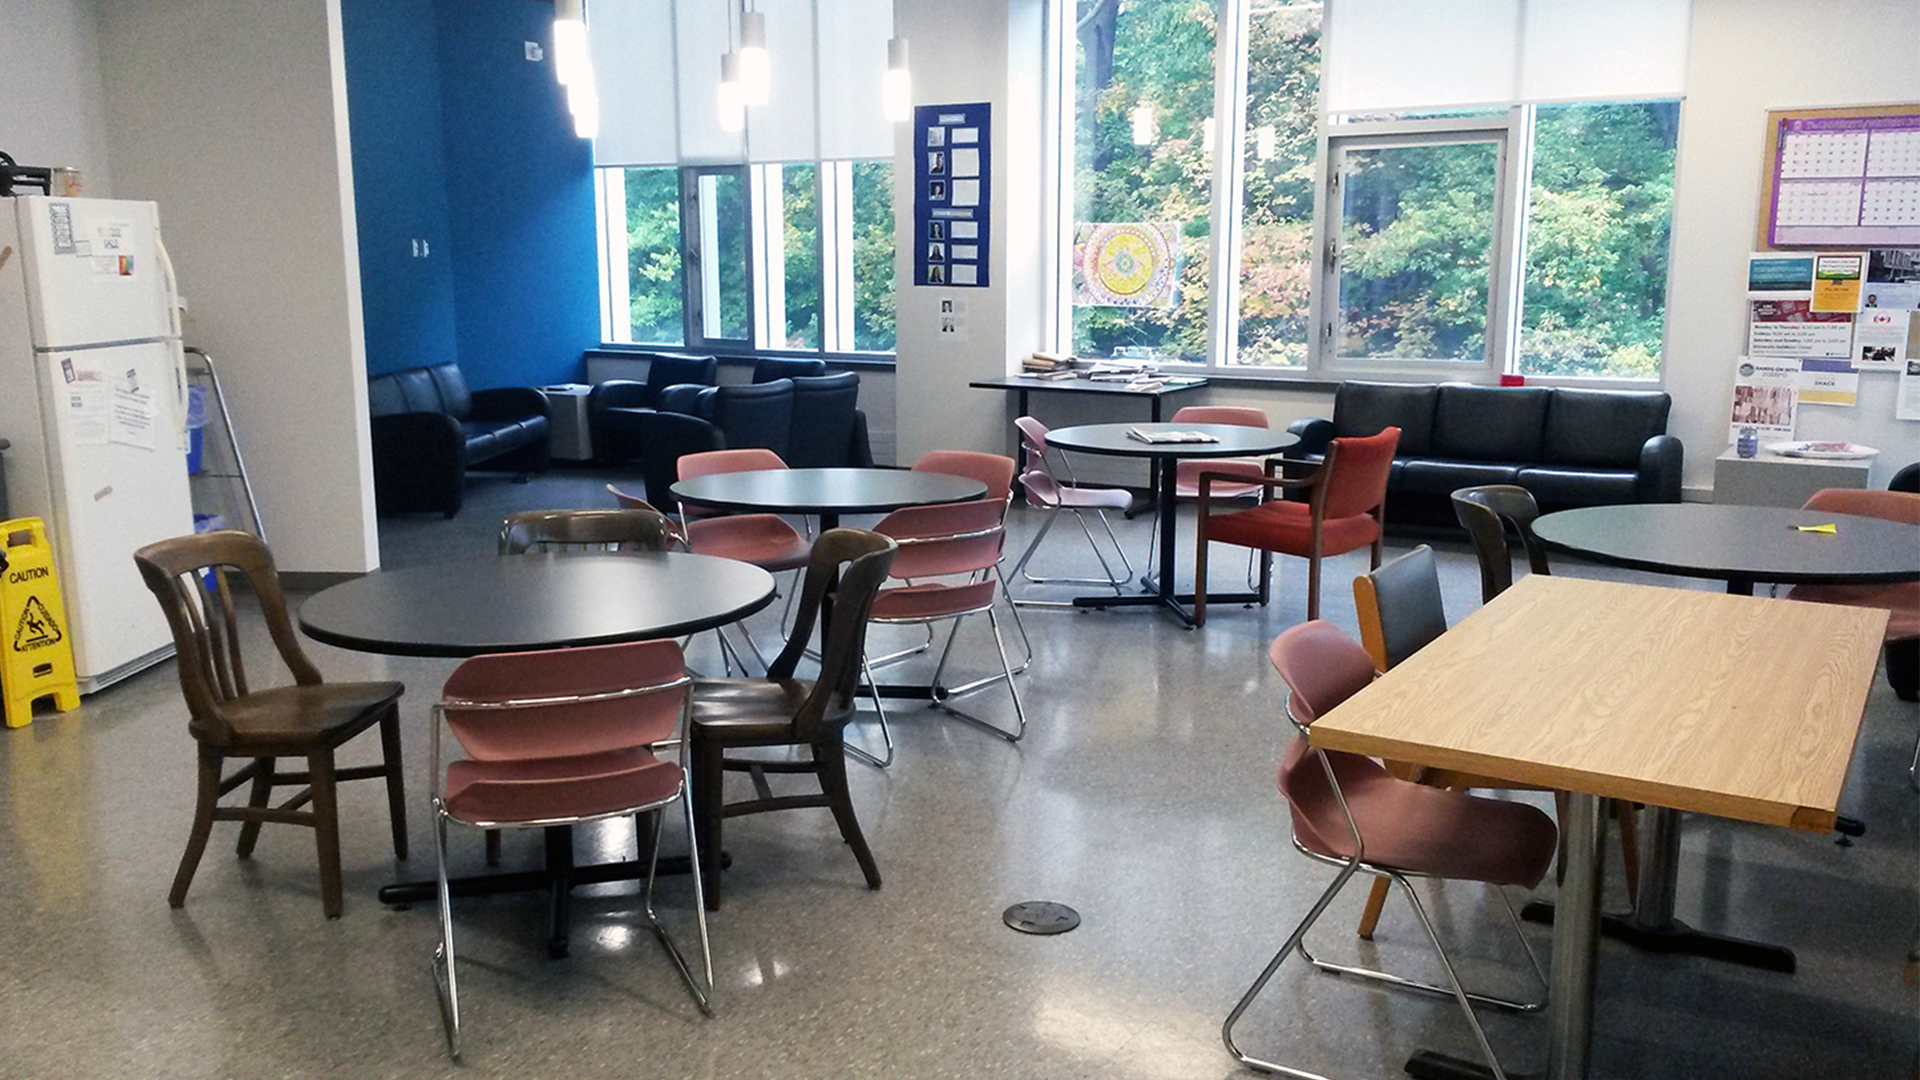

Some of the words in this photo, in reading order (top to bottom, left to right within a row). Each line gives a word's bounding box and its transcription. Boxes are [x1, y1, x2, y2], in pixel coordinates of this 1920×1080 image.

[10, 566, 49, 584] CAUTION
[14, 607, 30, 640] CAUTION
[21, 638, 56, 652] ATTENTION
